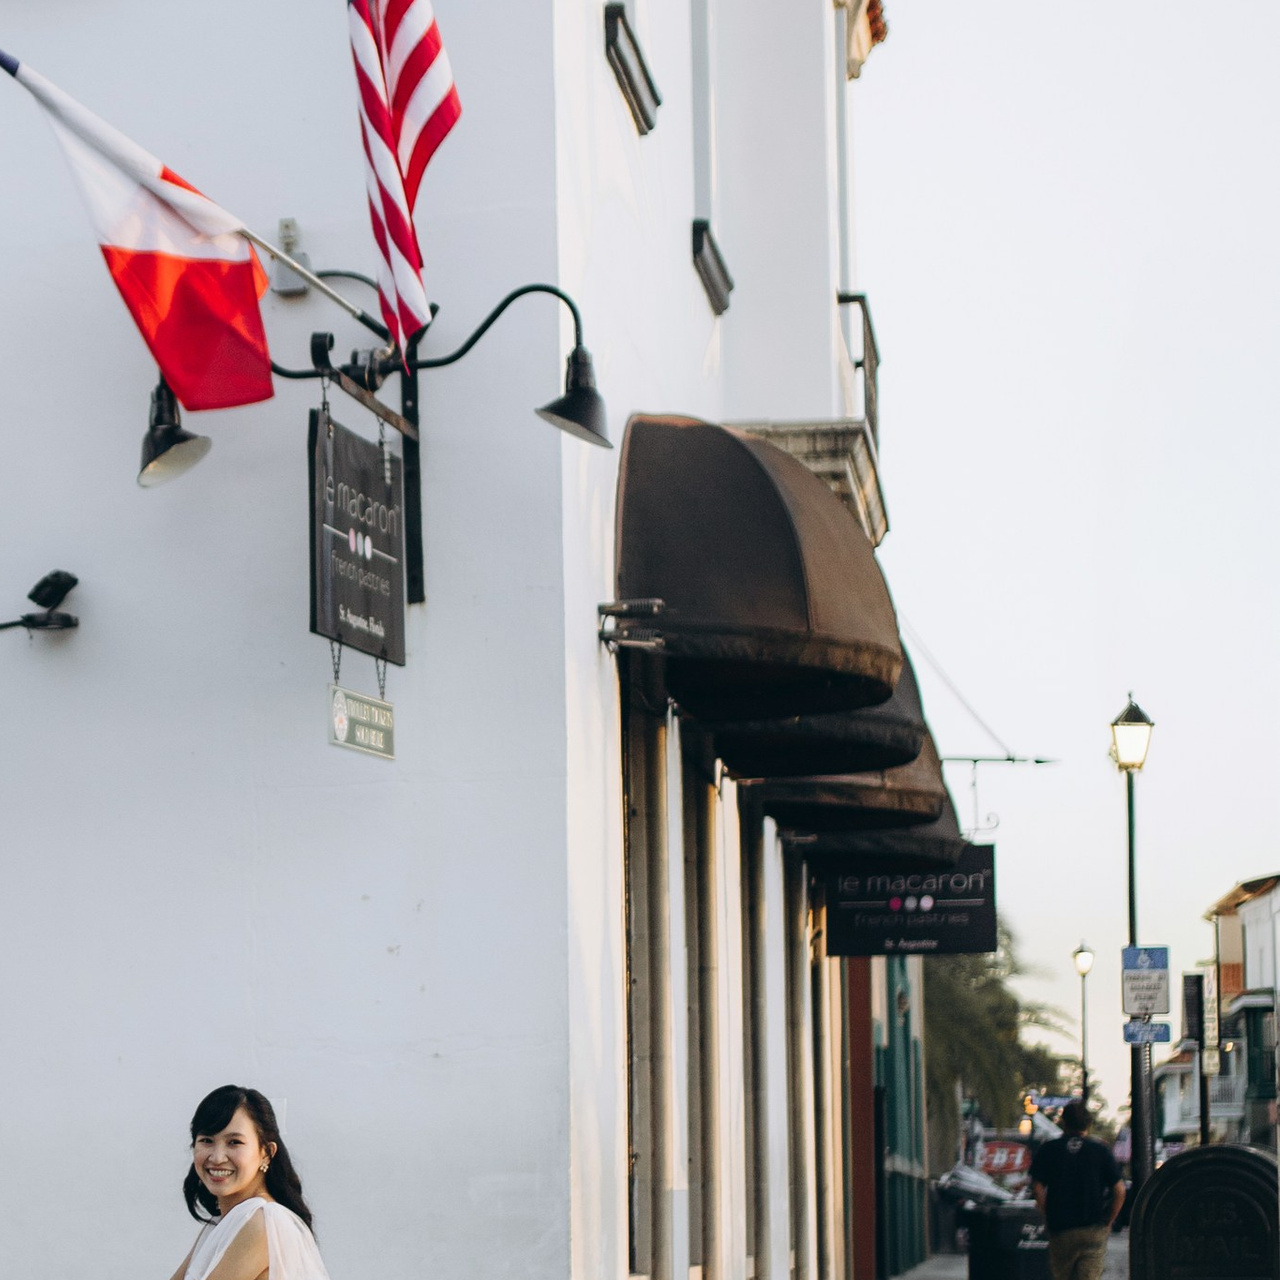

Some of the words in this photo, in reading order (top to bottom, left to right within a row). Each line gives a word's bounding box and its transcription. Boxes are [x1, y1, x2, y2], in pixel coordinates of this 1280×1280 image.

[322, 465, 335, 505] le
[337, 481, 398, 536] macaron
[838, 874, 860, 893] le
[867, 872, 985, 893] macaron
[854, 913, 904, 928] french
[906, 912, 970, 928] pastries
